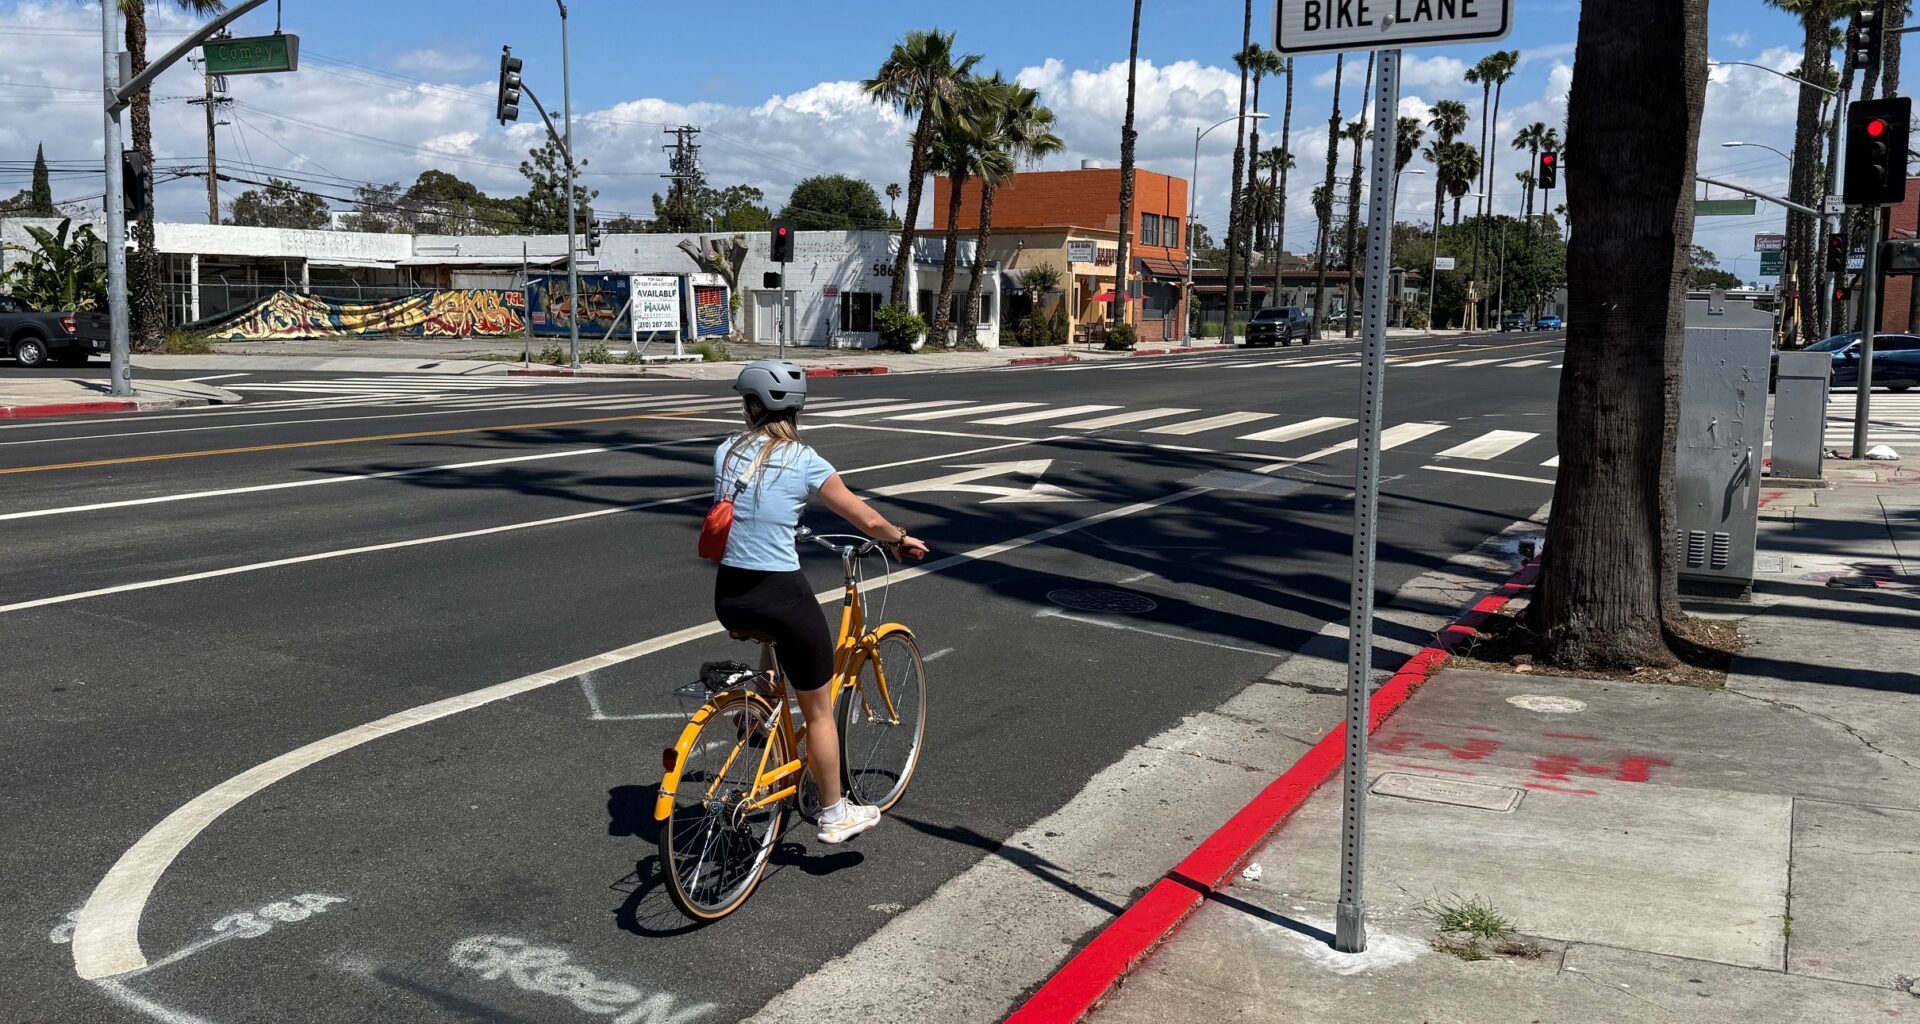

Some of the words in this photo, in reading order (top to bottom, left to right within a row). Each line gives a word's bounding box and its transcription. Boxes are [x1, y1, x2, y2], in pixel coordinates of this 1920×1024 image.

[1303, 0, 1373, 32] BIKE
[1395, 0, 1479, 24] LANE
[218, 45, 272, 61] Comey
[637, 289, 676, 298] AVAILABLE
[644, 301, 671, 312] MAXAM
